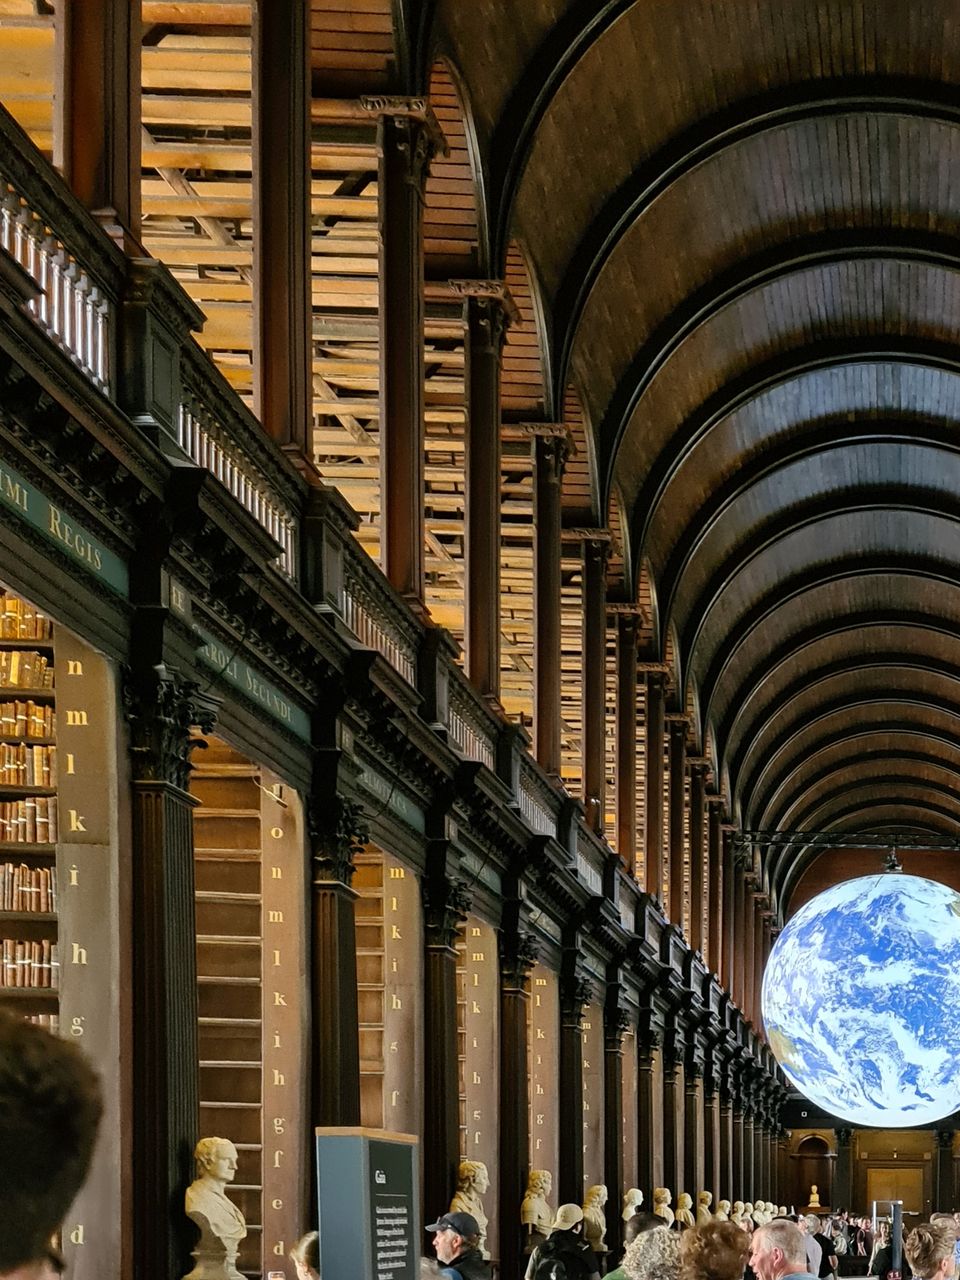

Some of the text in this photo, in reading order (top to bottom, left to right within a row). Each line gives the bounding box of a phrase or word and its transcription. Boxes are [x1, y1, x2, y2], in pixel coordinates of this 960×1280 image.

[49, 504, 102, 570] REGIS
[67, 660, 83, 675] n
[66, 709, 88, 725] m
[67, 754, 75, 775] l
[68, 810, 87, 832] k
[271, 827, 283, 839] o
[69, 864, 79, 886] i
[271, 867, 282, 879] n
[390, 867, 405, 879] m
[268, 910, 284, 923] m
[392, 925, 402, 939] k
[472, 927, 481, 936] n
[71, 943, 88, 964] h
[472, 952, 484, 961] m
[392, 958, 398, 972] i
[535, 978, 547, 986] m
[273, 992, 287, 1006] k
[392, 995, 402, 1010] h
[473, 1001, 481, 1013] k
[70, 1015, 85, 1037] g
[273, 1031, 281, 1048] i
[537, 1029, 545, 1039] k
[473, 1038, 478, 1048] i
[537, 1055, 542, 1065] i
[273, 1069, 285, 1086] h
[473, 1072, 481, 1085] h
[536, 1085, 544, 1095] h
[391, 1090, 400, 1106] f
[273, 1117, 286, 1135] g
[536, 1113, 544, 1125] g
[474, 1132, 481, 1144] f
[535, 1139, 542, 1149] f
[273, 1150, 284, 1168] f
[272, 1199, 283, 1209] e
[70, 1225, 84, 1244] d
[273, 1241, 284, 1256] d
